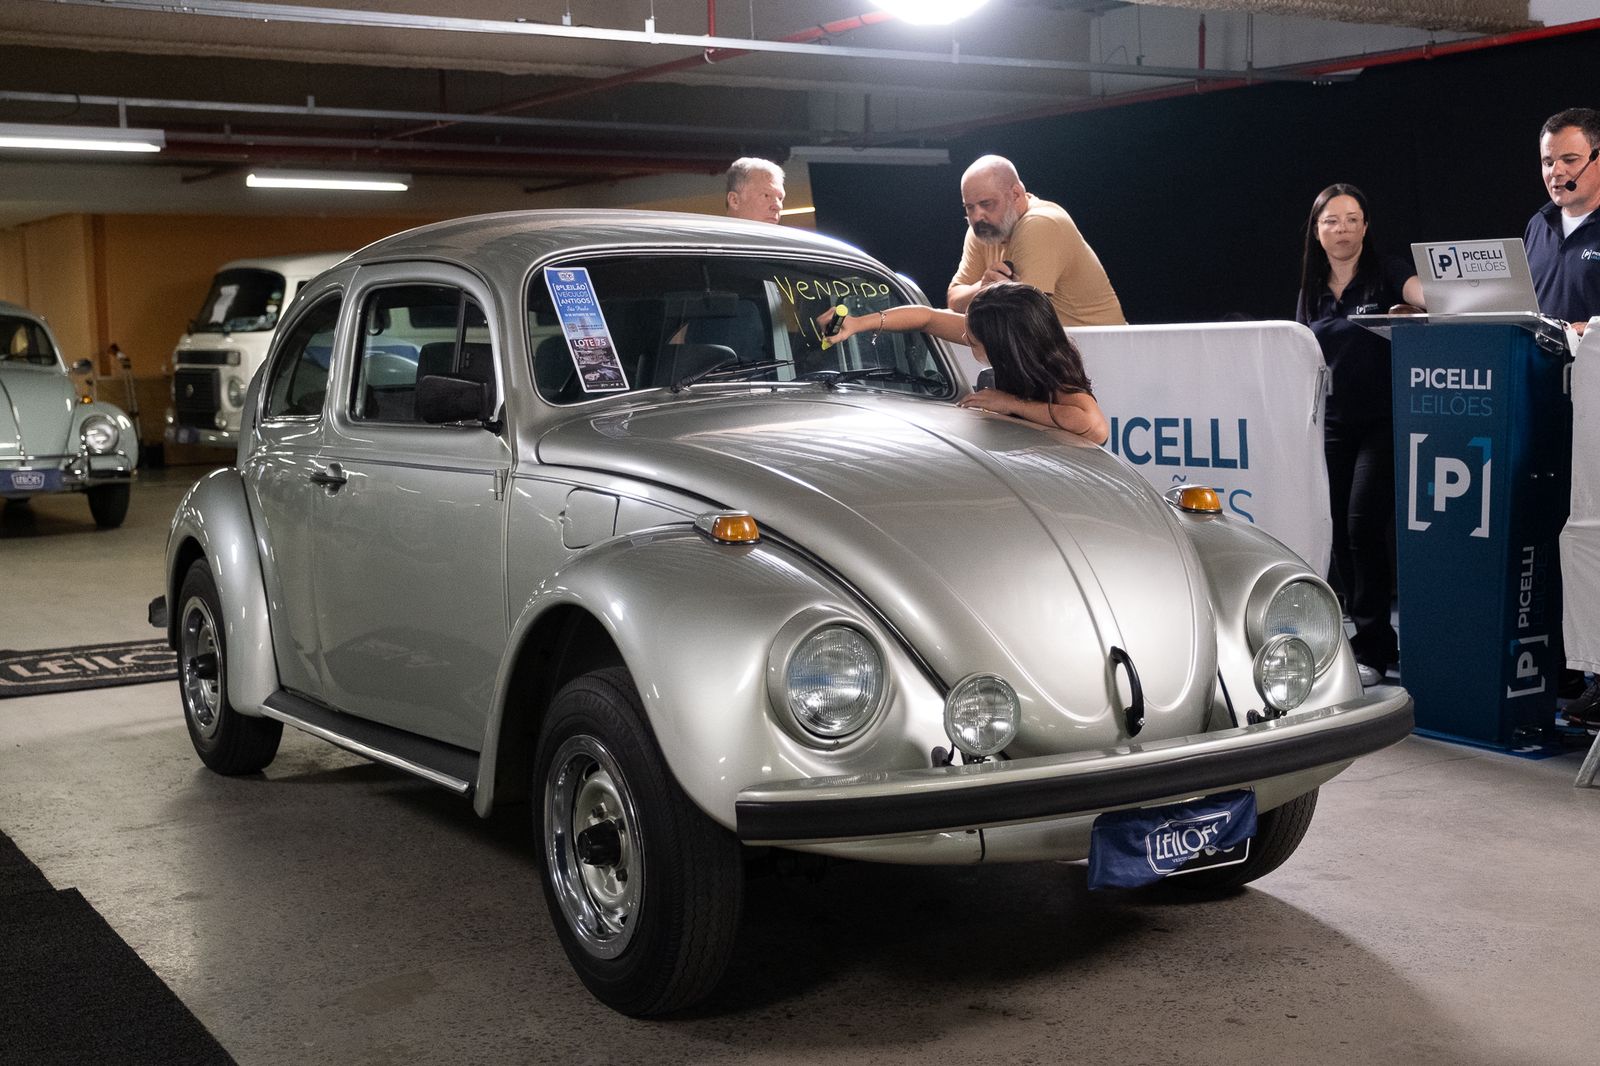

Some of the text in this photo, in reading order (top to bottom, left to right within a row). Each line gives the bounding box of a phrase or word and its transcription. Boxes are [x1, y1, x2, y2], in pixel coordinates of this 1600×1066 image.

[1462, 249, 1503, 261] PICELLI
[1465, 261, 1507, 273] LEILÕES
[573, 338, 595, 347] LOTE
[1410, 367, 1493, 391] PICELLI
[1410, 392, 1493, 417] LEILÕES
[1101, 416, 1249, 470] ICELLI
[1518, 546, 1535, 629] PICELLI
